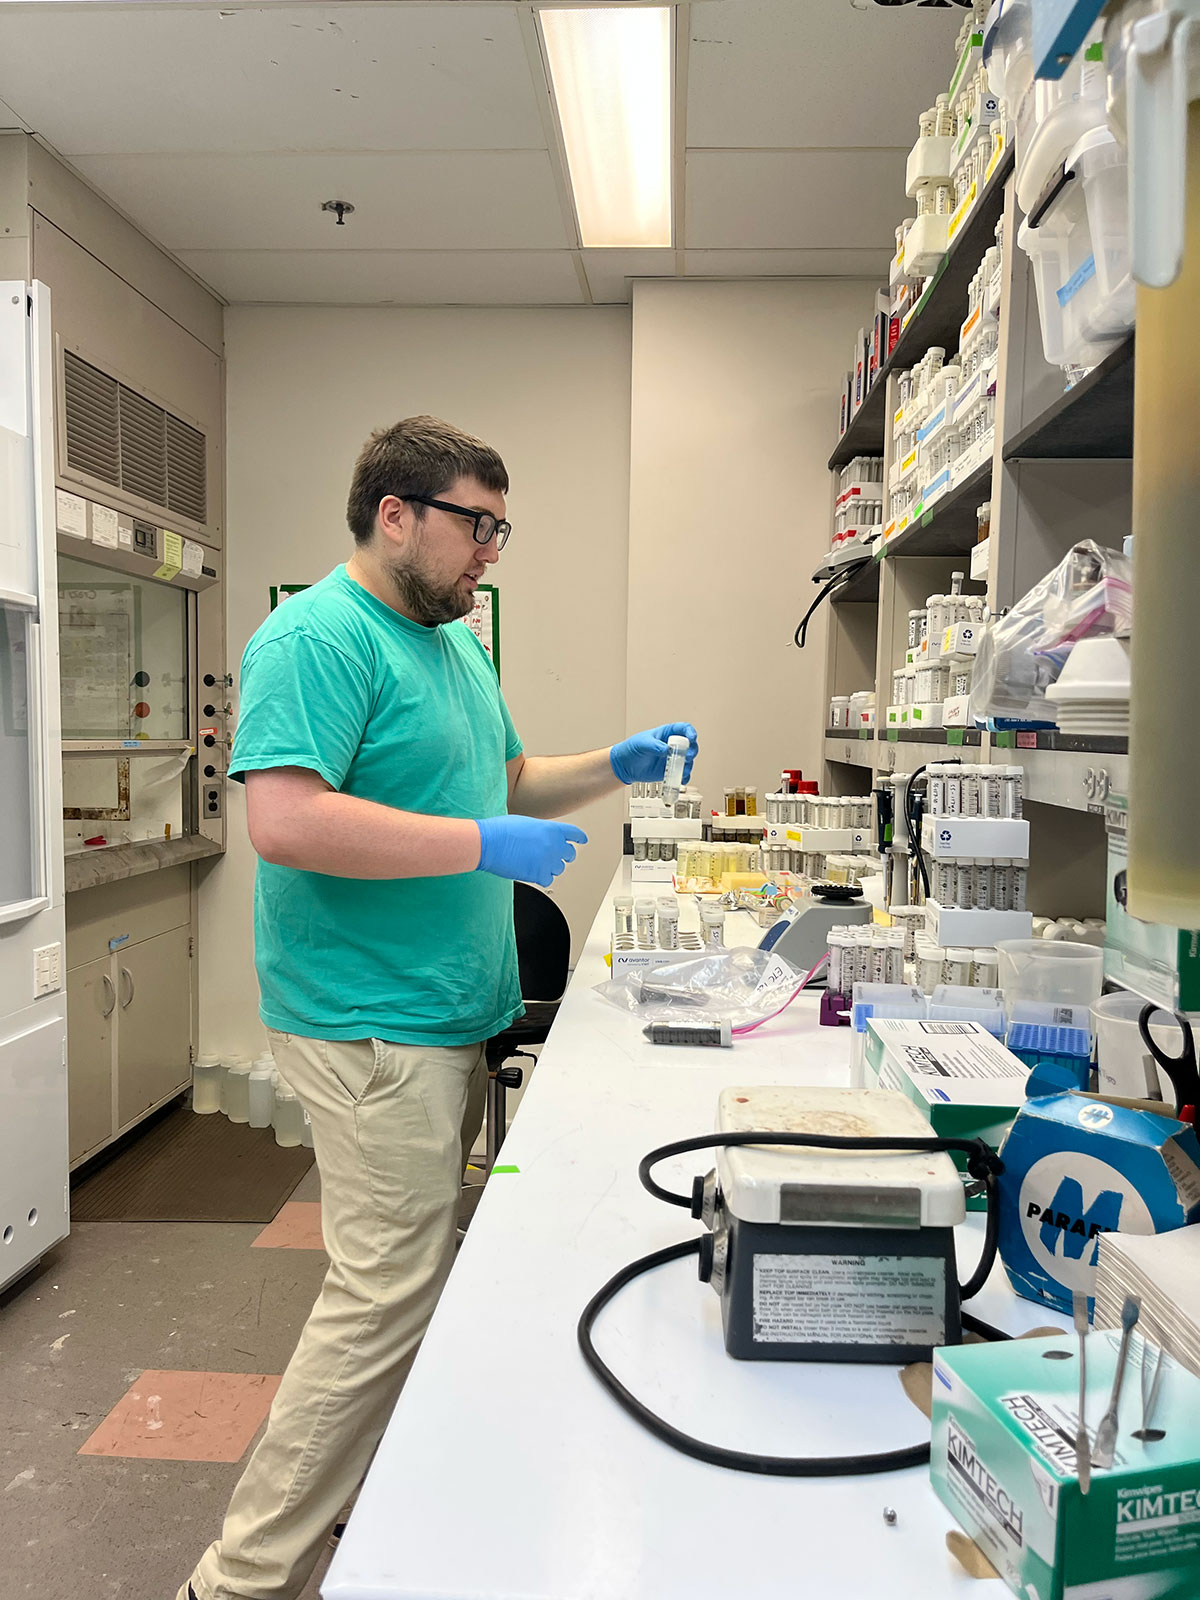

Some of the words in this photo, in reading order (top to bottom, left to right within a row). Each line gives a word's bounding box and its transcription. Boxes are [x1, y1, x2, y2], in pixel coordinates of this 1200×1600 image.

[1026, 1202, 1121, 1239] PARAF
[948, 1427, 1023, 1533] KIMTECH
[1116, 1484, 1163, 1499] Kimwipes
